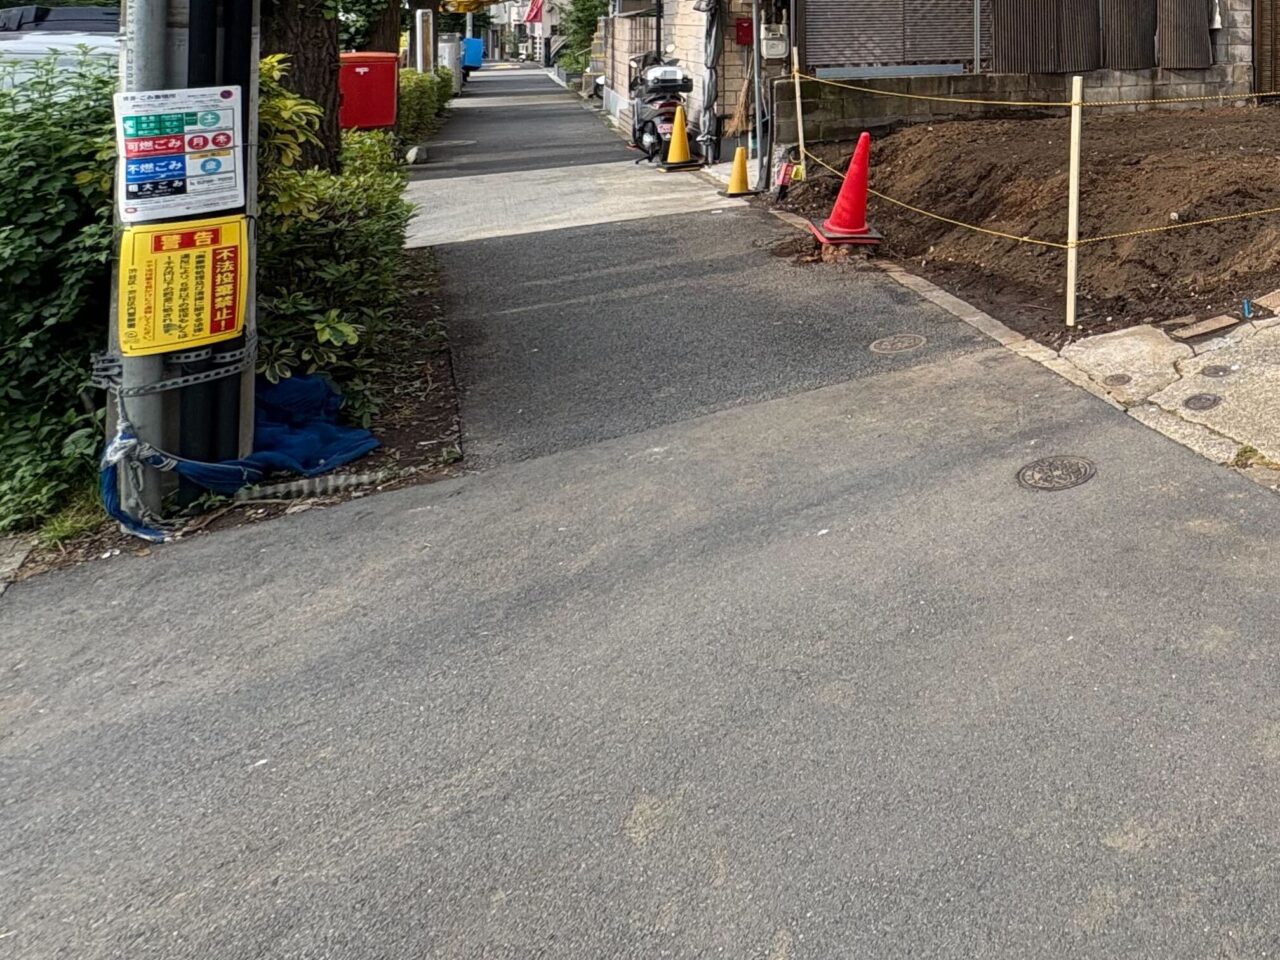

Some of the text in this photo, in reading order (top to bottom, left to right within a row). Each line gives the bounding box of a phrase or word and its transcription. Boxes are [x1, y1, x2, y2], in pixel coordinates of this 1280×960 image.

[205, 113, 216, 124] 土
[127, 134, 227, 151] 可燃ごみ 月 木
[127, 160, 183, 174] 不燃ごみ
[160, 231, 214, 250] 警告
